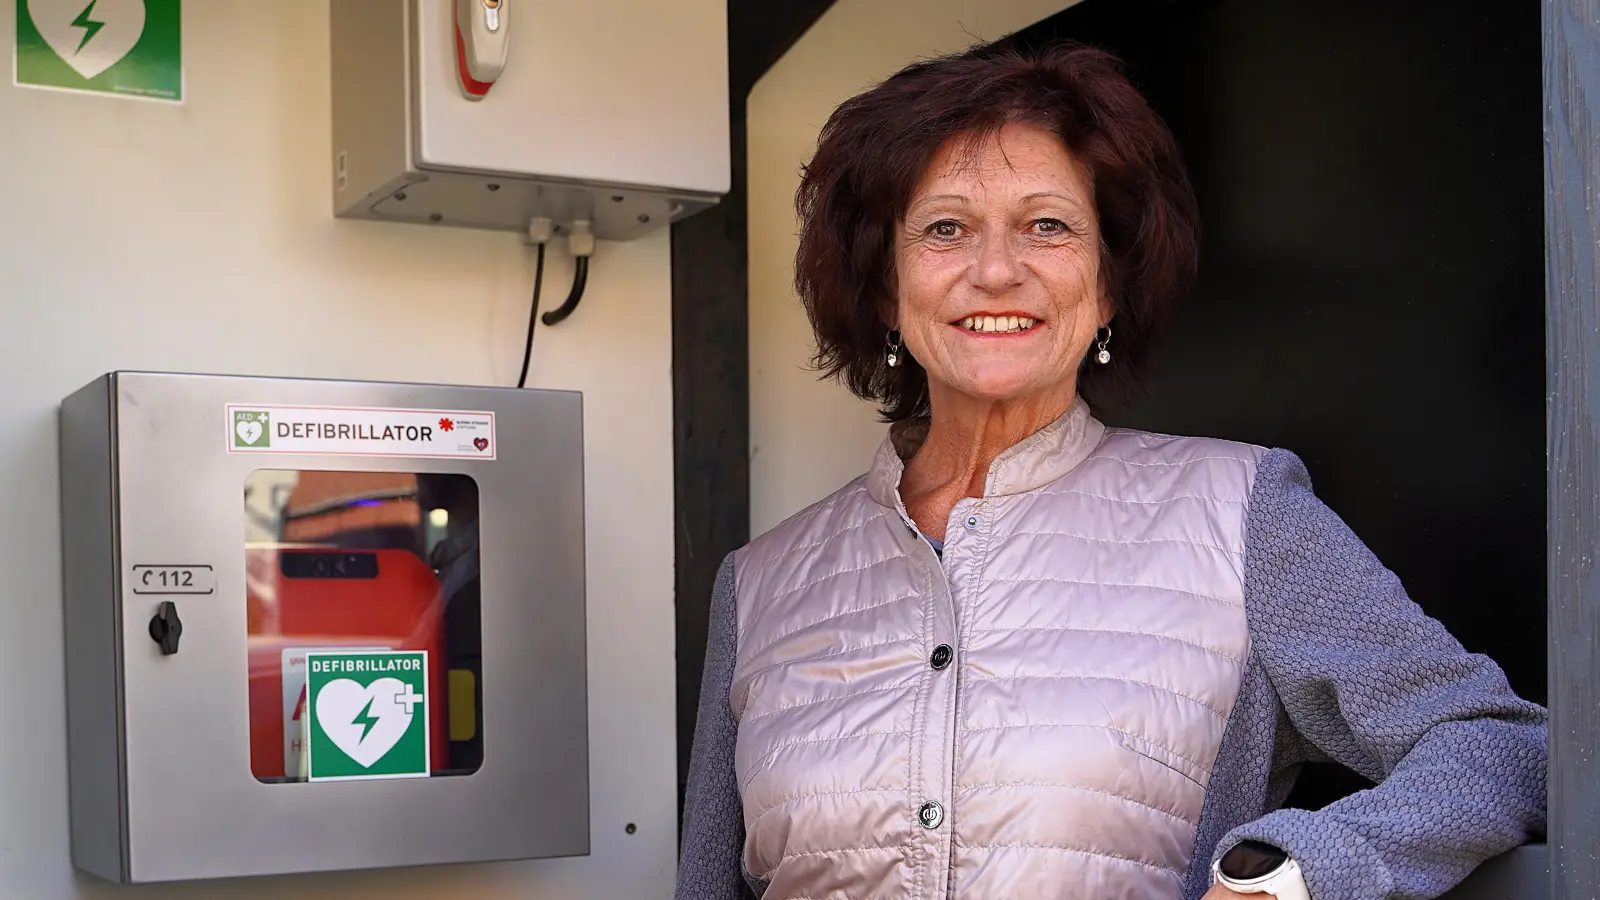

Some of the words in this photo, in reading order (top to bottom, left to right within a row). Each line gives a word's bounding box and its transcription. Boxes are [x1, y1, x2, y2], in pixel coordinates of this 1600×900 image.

[277, 422, 432, 441] DEFIBRILLATOR
[159, 570, 193, 586] 112
[312, 659, 421, 672] DEFIBRILLATOR
